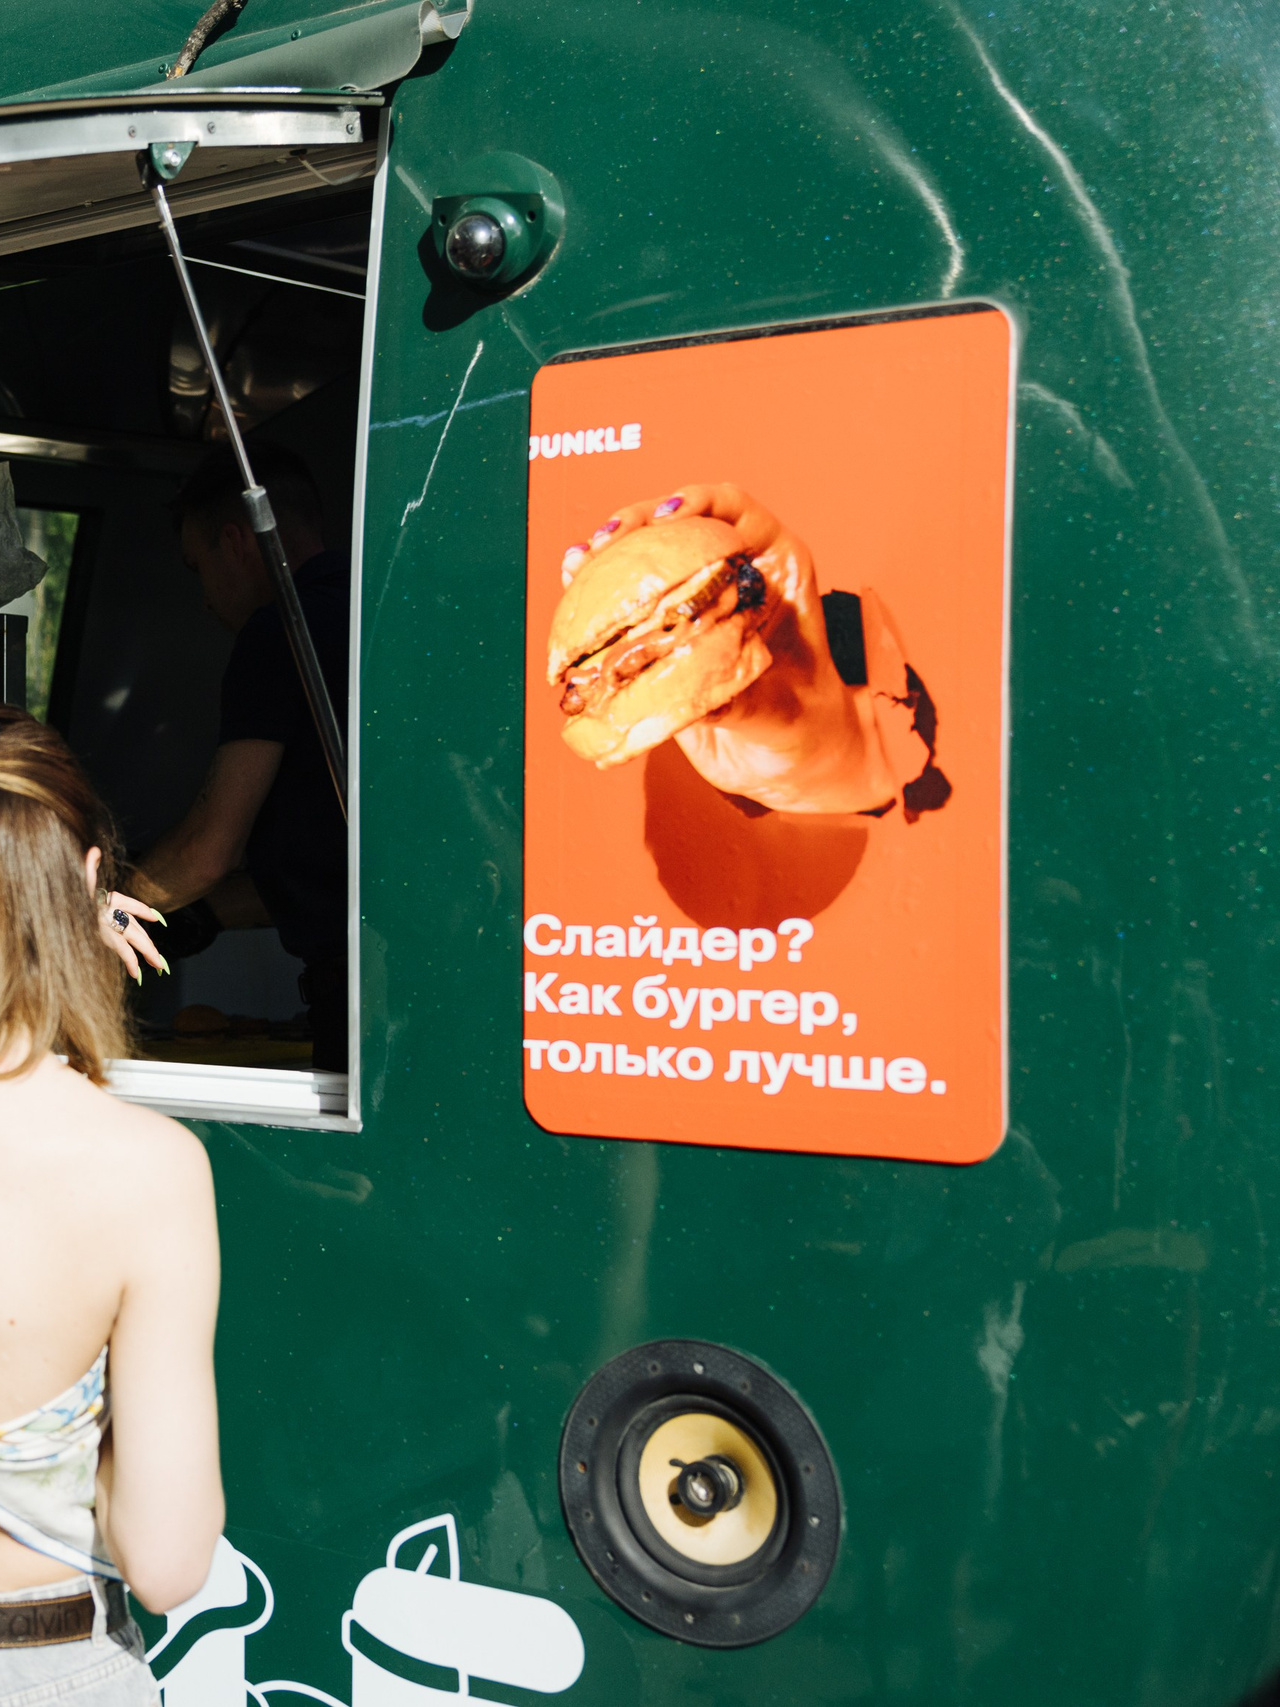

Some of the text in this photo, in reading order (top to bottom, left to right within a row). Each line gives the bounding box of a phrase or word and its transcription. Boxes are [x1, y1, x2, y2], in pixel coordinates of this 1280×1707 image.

[528, 423, 641, 460] JUNKLE
[523, 914, 814, 971] Слайдер?
[524, 972, 858, 1036] Как бургер,
[523, 1038, 947, 1095] только лучше.
